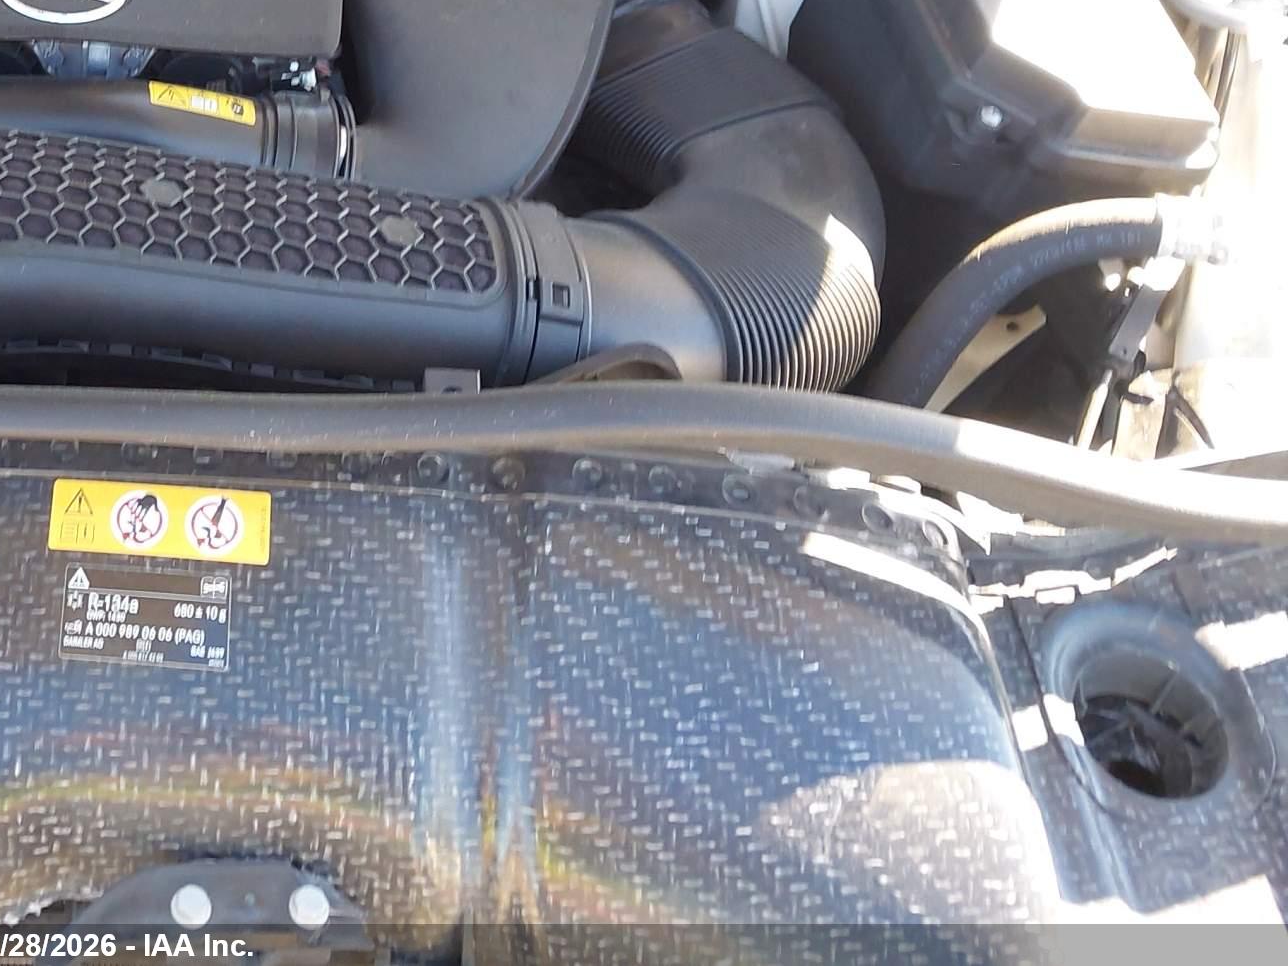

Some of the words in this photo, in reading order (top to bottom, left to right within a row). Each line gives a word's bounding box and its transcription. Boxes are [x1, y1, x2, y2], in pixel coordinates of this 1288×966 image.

[174, 602, 194, 618] 680
[206, 605, 218, 621] 10
[85, 621, 94, 636] A
[95, 622, 117, 638] 000
[141, 625, 156, 641] 06
[158, 626, 173, 642] 06
[174, 628, 205, 646] (PAG)
